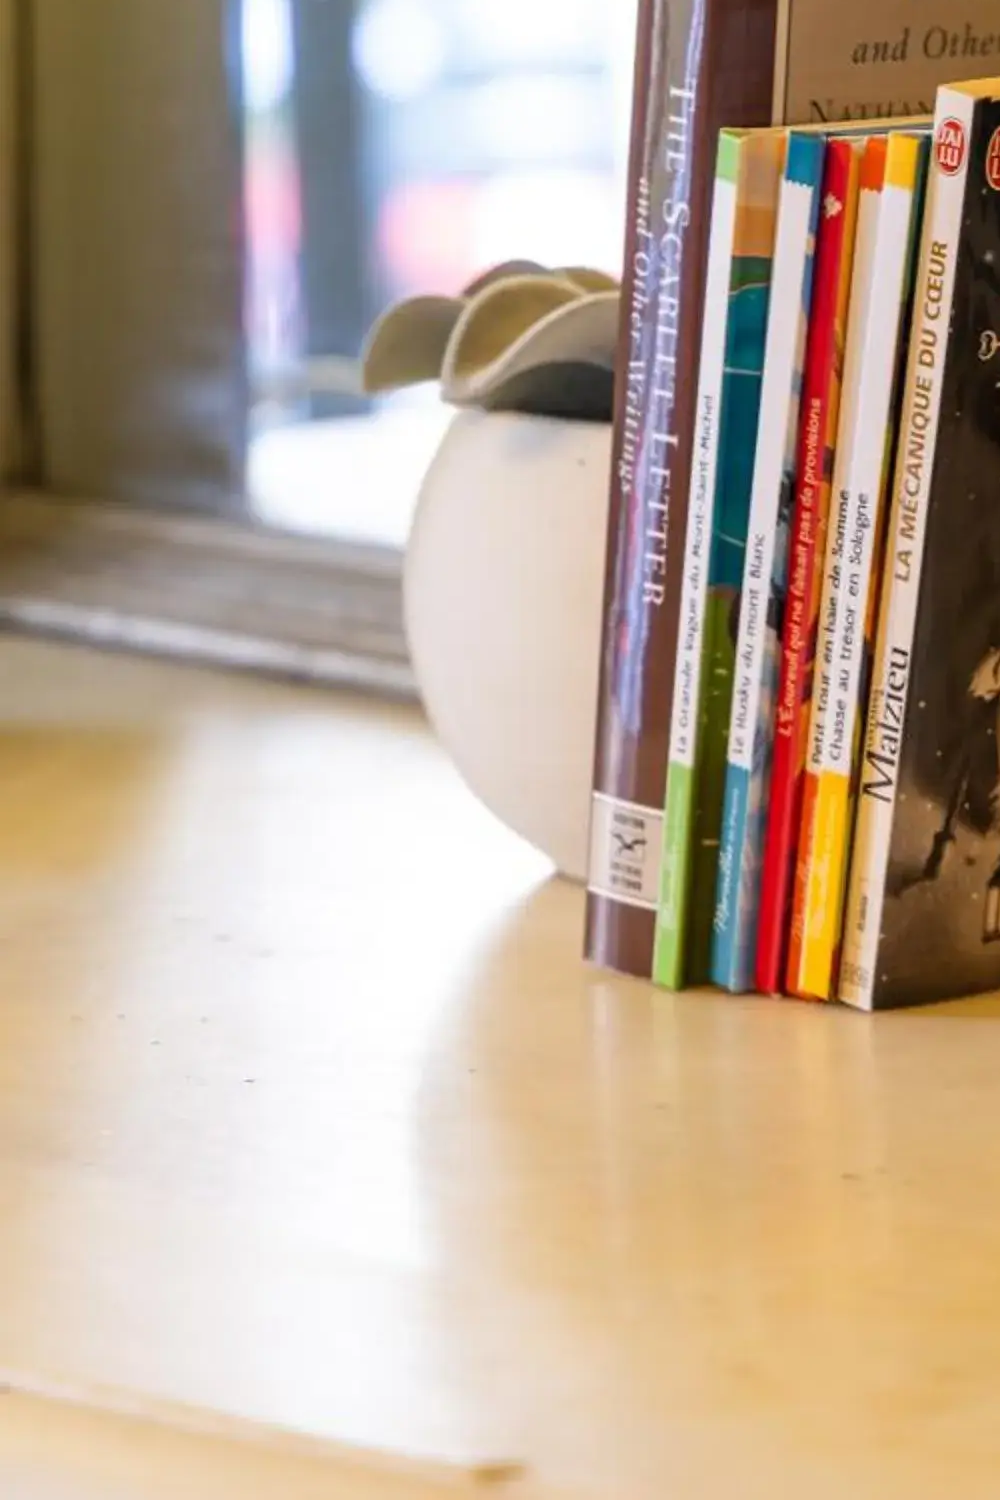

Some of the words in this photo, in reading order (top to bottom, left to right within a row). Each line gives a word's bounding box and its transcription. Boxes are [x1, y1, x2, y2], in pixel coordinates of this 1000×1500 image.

[851, 27, 908, 66] and
[664, 78, 697, 172] THE
[938, 145, 960, 167] LU
[636, 178, 654, 238] and
[632, 251, 651, 342] Other
[653, 200, 689, 408] SCARLET
[922, 239, 949, 322] CŒUR
[916, 328, 938, 370] DU
[619, 360, 646, 494] Writings
[803, 398, 820, 486] provisions
[897, 377, 933, 541] MÉCANIQUE
[643, 432, 678, 605] LETTER
[800, 487, 812, 507] de
[799, 511, 814, 544] pas
[831, 490, 848, 558] Somme
[849, 493, 871, 565] Sologne
[748, 532, 766, 581] Blanc
[828, 565, 840, 589] de
[894, 549, 915, 584] LA
[849, 573, 860, 597] en
[745, 589, 760, 638] mont
[741, 643, 754, 670] du
[822, 640, 833, 664] en
[735, 676, 751, 730] Husky
[817, 674, 831, 712] tour
[839, 669, 849, 692] au
[812, 723, 825, 765] Petit
[829, 698, 847, 761] Chasse
[861, 645, 909, 804] Malzieu
